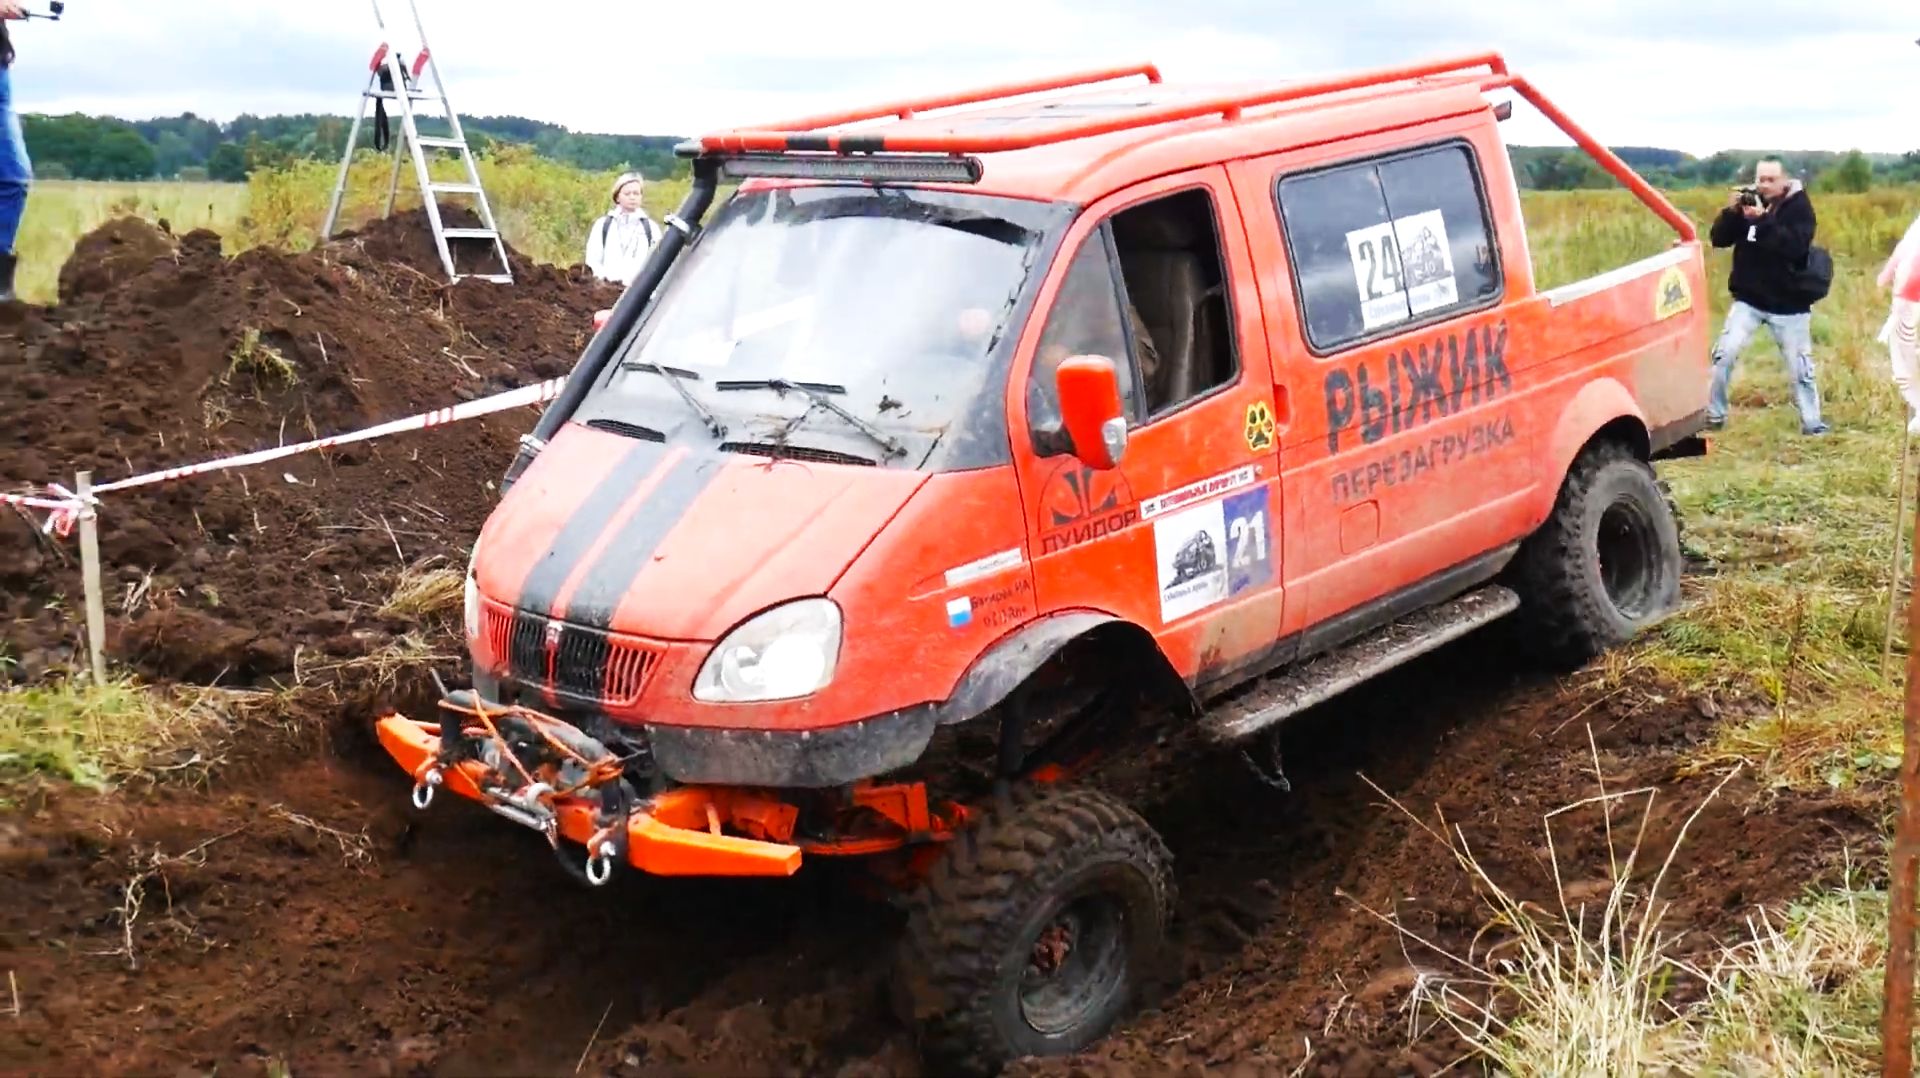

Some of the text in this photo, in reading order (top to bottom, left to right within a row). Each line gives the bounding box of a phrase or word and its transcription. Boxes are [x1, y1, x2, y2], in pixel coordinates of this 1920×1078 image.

[1358, 235, 1402, 300] 24
[1324, 319, 1512, 456] РЫЖИК
[1331, 415, 1516, 504] ПЕРЕЗАГРУЗКА
[1041, 509, 1137, 556] ЛУИДОР
[1230, 510, 1265, 568] 21
